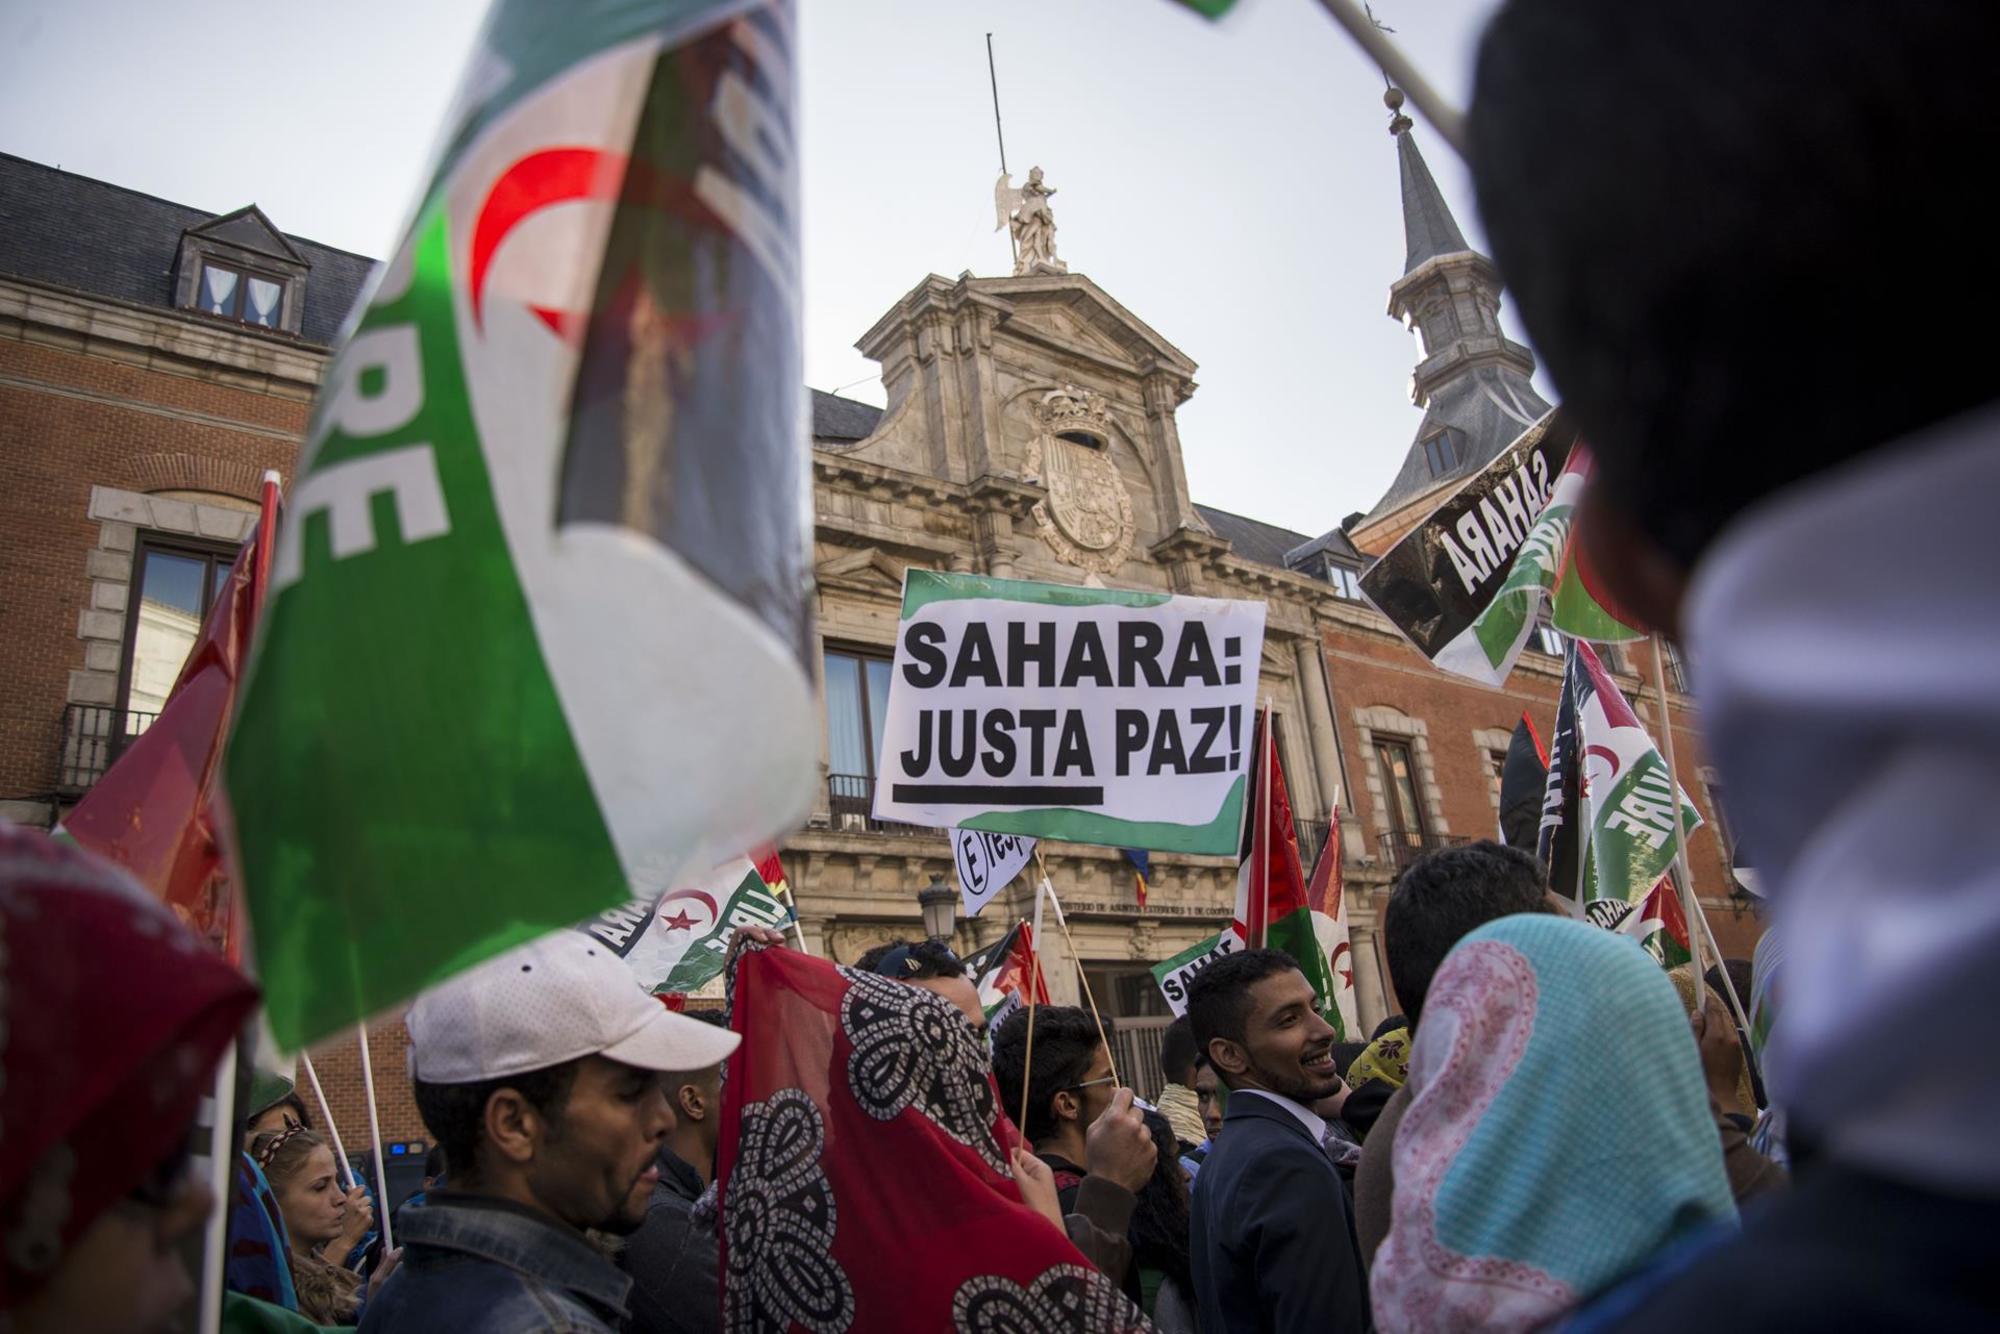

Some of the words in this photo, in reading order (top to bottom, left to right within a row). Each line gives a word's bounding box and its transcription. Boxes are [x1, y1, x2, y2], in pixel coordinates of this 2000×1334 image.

[902, 621, 1242, 688] SAHARA:
[900, 708, 1095, 778] JUSTA
[1115, 704, 1242, 776] PAZ!
